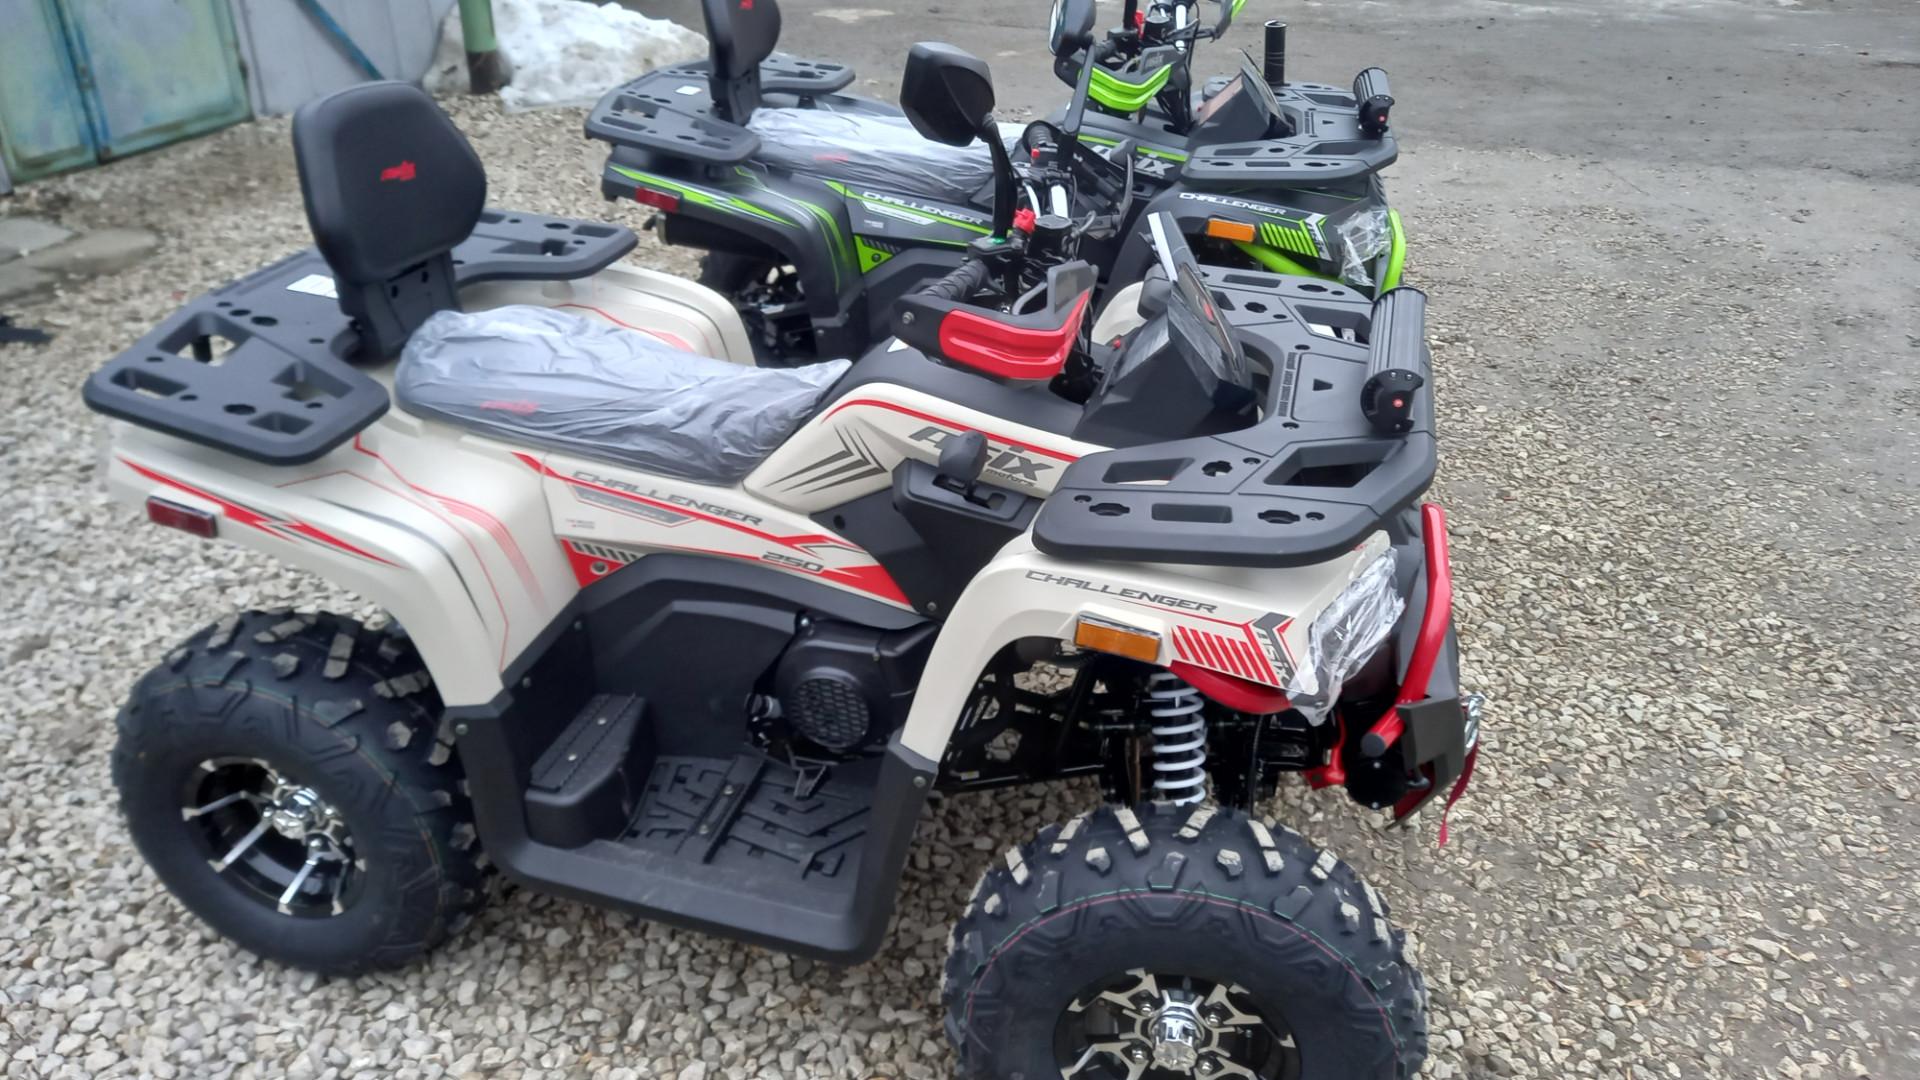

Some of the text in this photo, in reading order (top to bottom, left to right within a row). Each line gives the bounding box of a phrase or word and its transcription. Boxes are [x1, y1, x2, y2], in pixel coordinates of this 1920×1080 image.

[862, 191, 983, 225] CHALLENGER
[1179, 192, 1287, 215] CHALLENGER
[985, 468, 1036, 488] motors
[573, 471, 763, 526] CHALLENGER
[762, 551, 825, 573] 250
[1025, 570, 1218, 614] CHALLENGER
